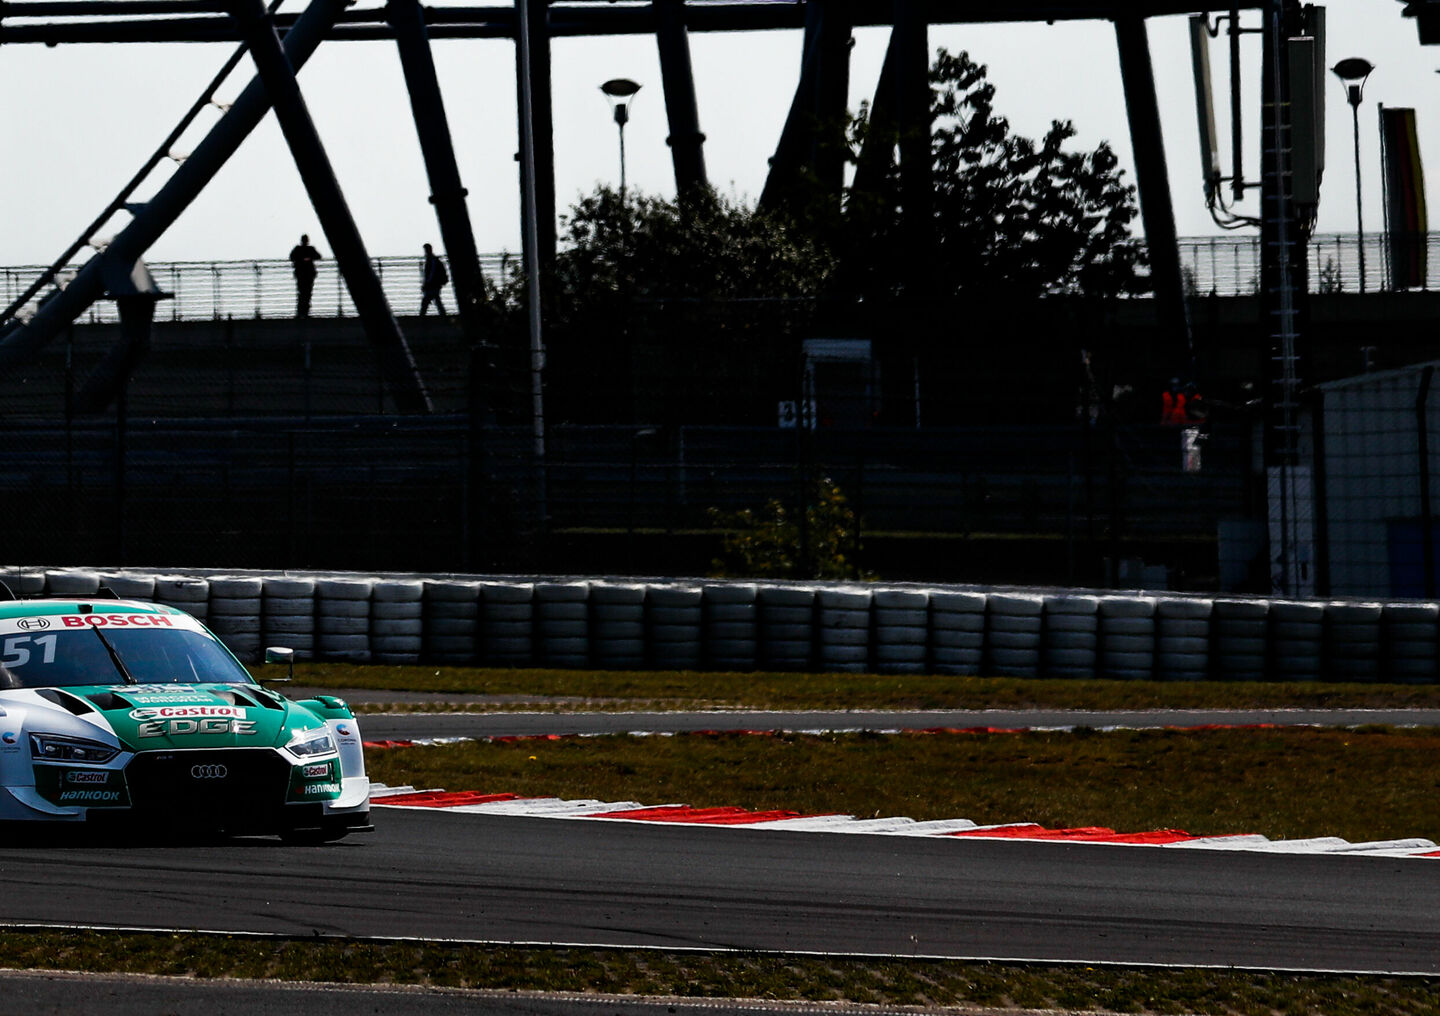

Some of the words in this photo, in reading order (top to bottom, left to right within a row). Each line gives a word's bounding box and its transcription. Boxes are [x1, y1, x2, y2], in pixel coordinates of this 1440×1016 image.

[61, 615, 173, 627] BOSCH
[1, 634, 58, 669] 51
[159, 707, 243, 718] Castrol
[138, 719, 258, 739] EDGE
[76, 772, 106, 783] Castrol
